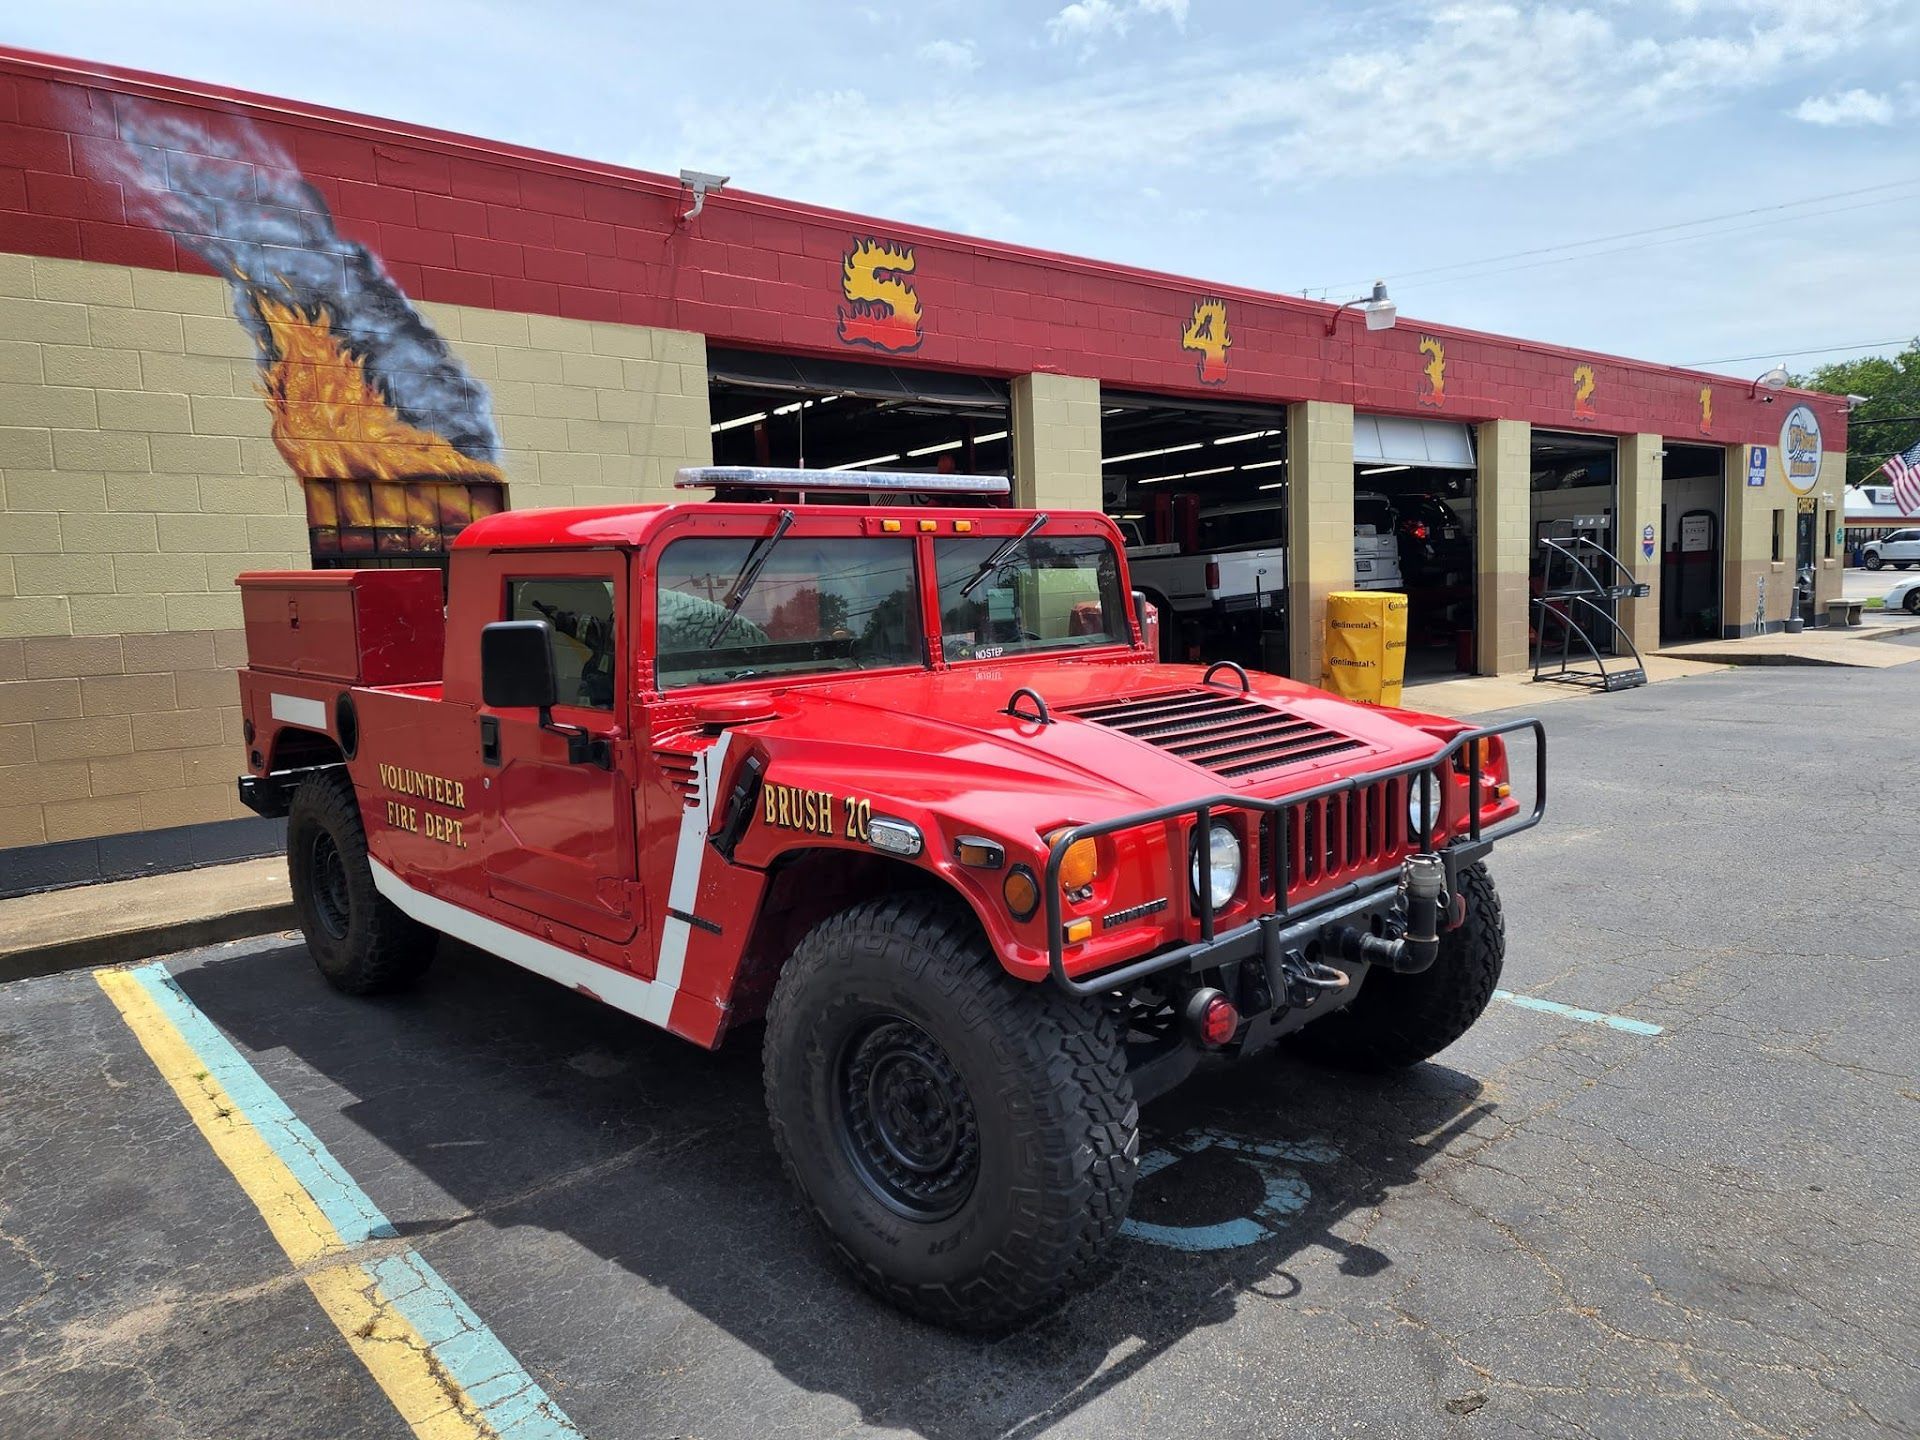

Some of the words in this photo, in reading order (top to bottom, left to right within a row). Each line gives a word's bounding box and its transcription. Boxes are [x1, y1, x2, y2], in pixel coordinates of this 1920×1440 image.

[838, 236, 923, 354] 5
[1181, 296, 1233, 386] 4
[1418, 335, 1446, 409] 3
[1573, 363, 1596, 422] 2
[1700, 385, 1713, 436] 1
[1331, 619, 1371, 630] Continental
[1330, 656, 1369, 668] Continental
[379, 763, 465, 809] VOLUNTEER
[764, 783, 833, 835] BRUSH
[387, 801, 418, 833] FIRE
[424, 811, 467, 850] DEPT.
